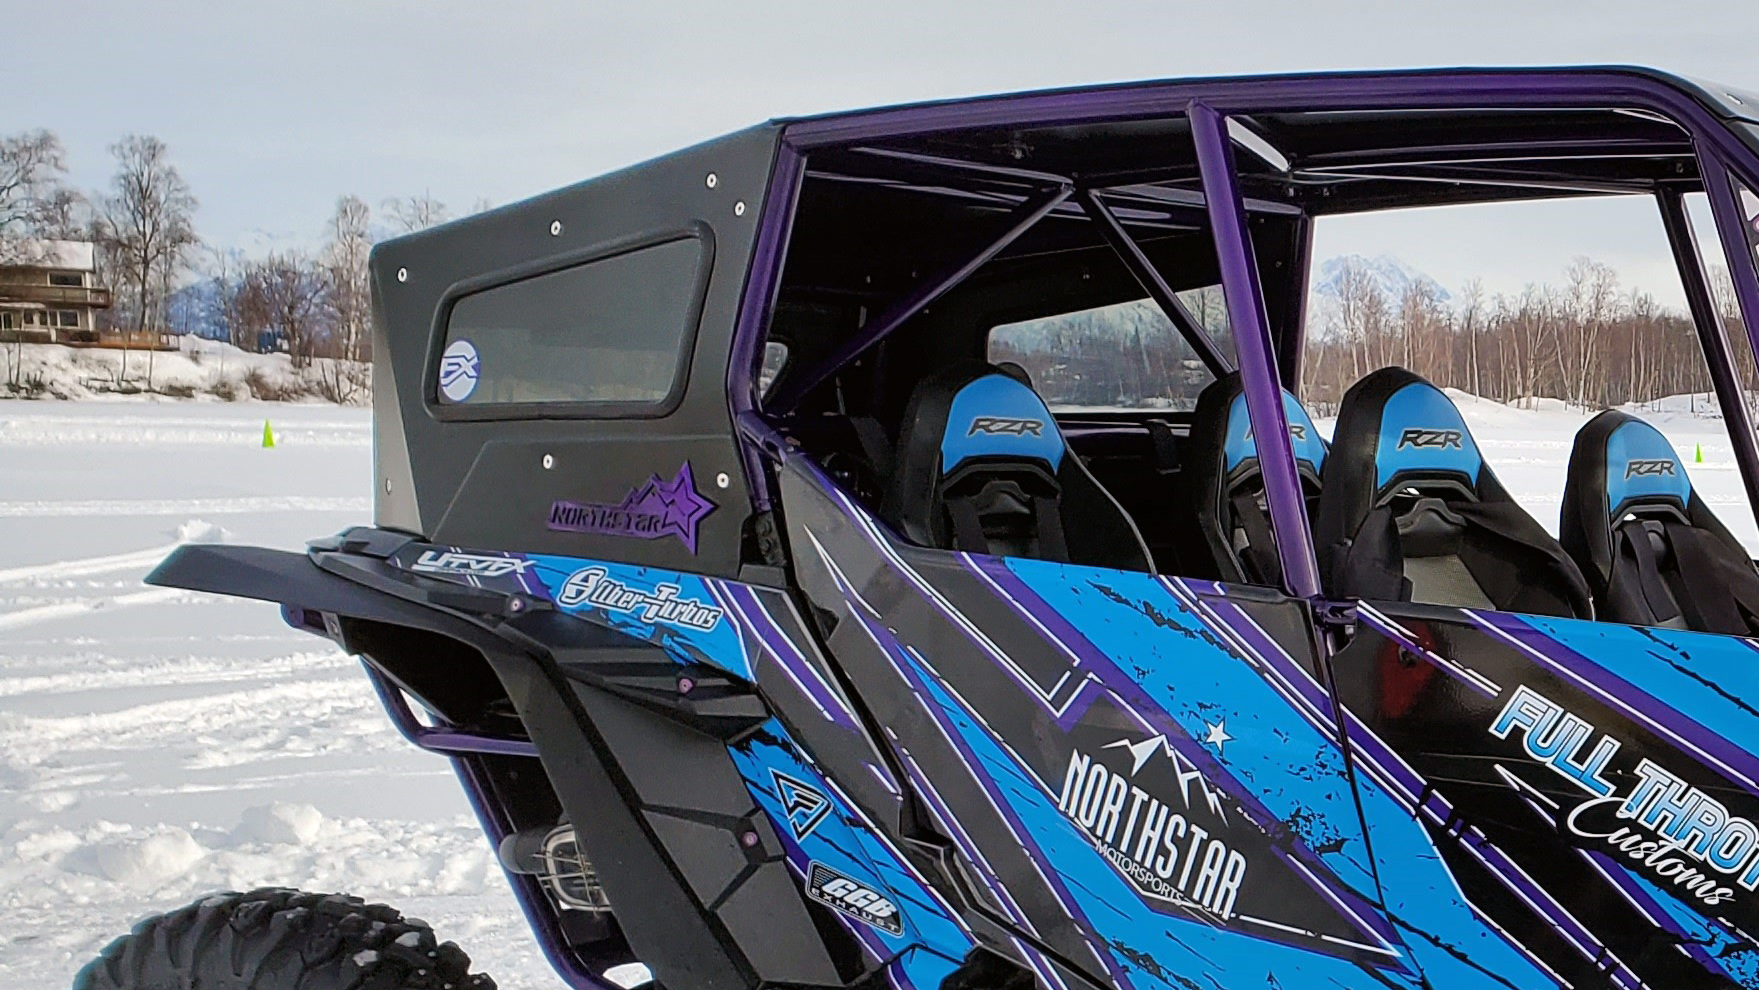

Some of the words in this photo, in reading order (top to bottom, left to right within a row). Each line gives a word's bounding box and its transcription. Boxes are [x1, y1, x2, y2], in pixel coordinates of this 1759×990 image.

[967, 416, 1044, 437] RZR
[1397, 429, 1463, 450] RZR
[1624, 459, 1677, 480] RZR
[1488, 684, 1622, 799] FULL
[1058, 747, 1247, 922] NORTHSTAR
[1566, 796, 1737, 906] Customs
[1095, 839, 1184, 905] MOTORSPORTS
[811, 886, 899, 932] EXHAUST
